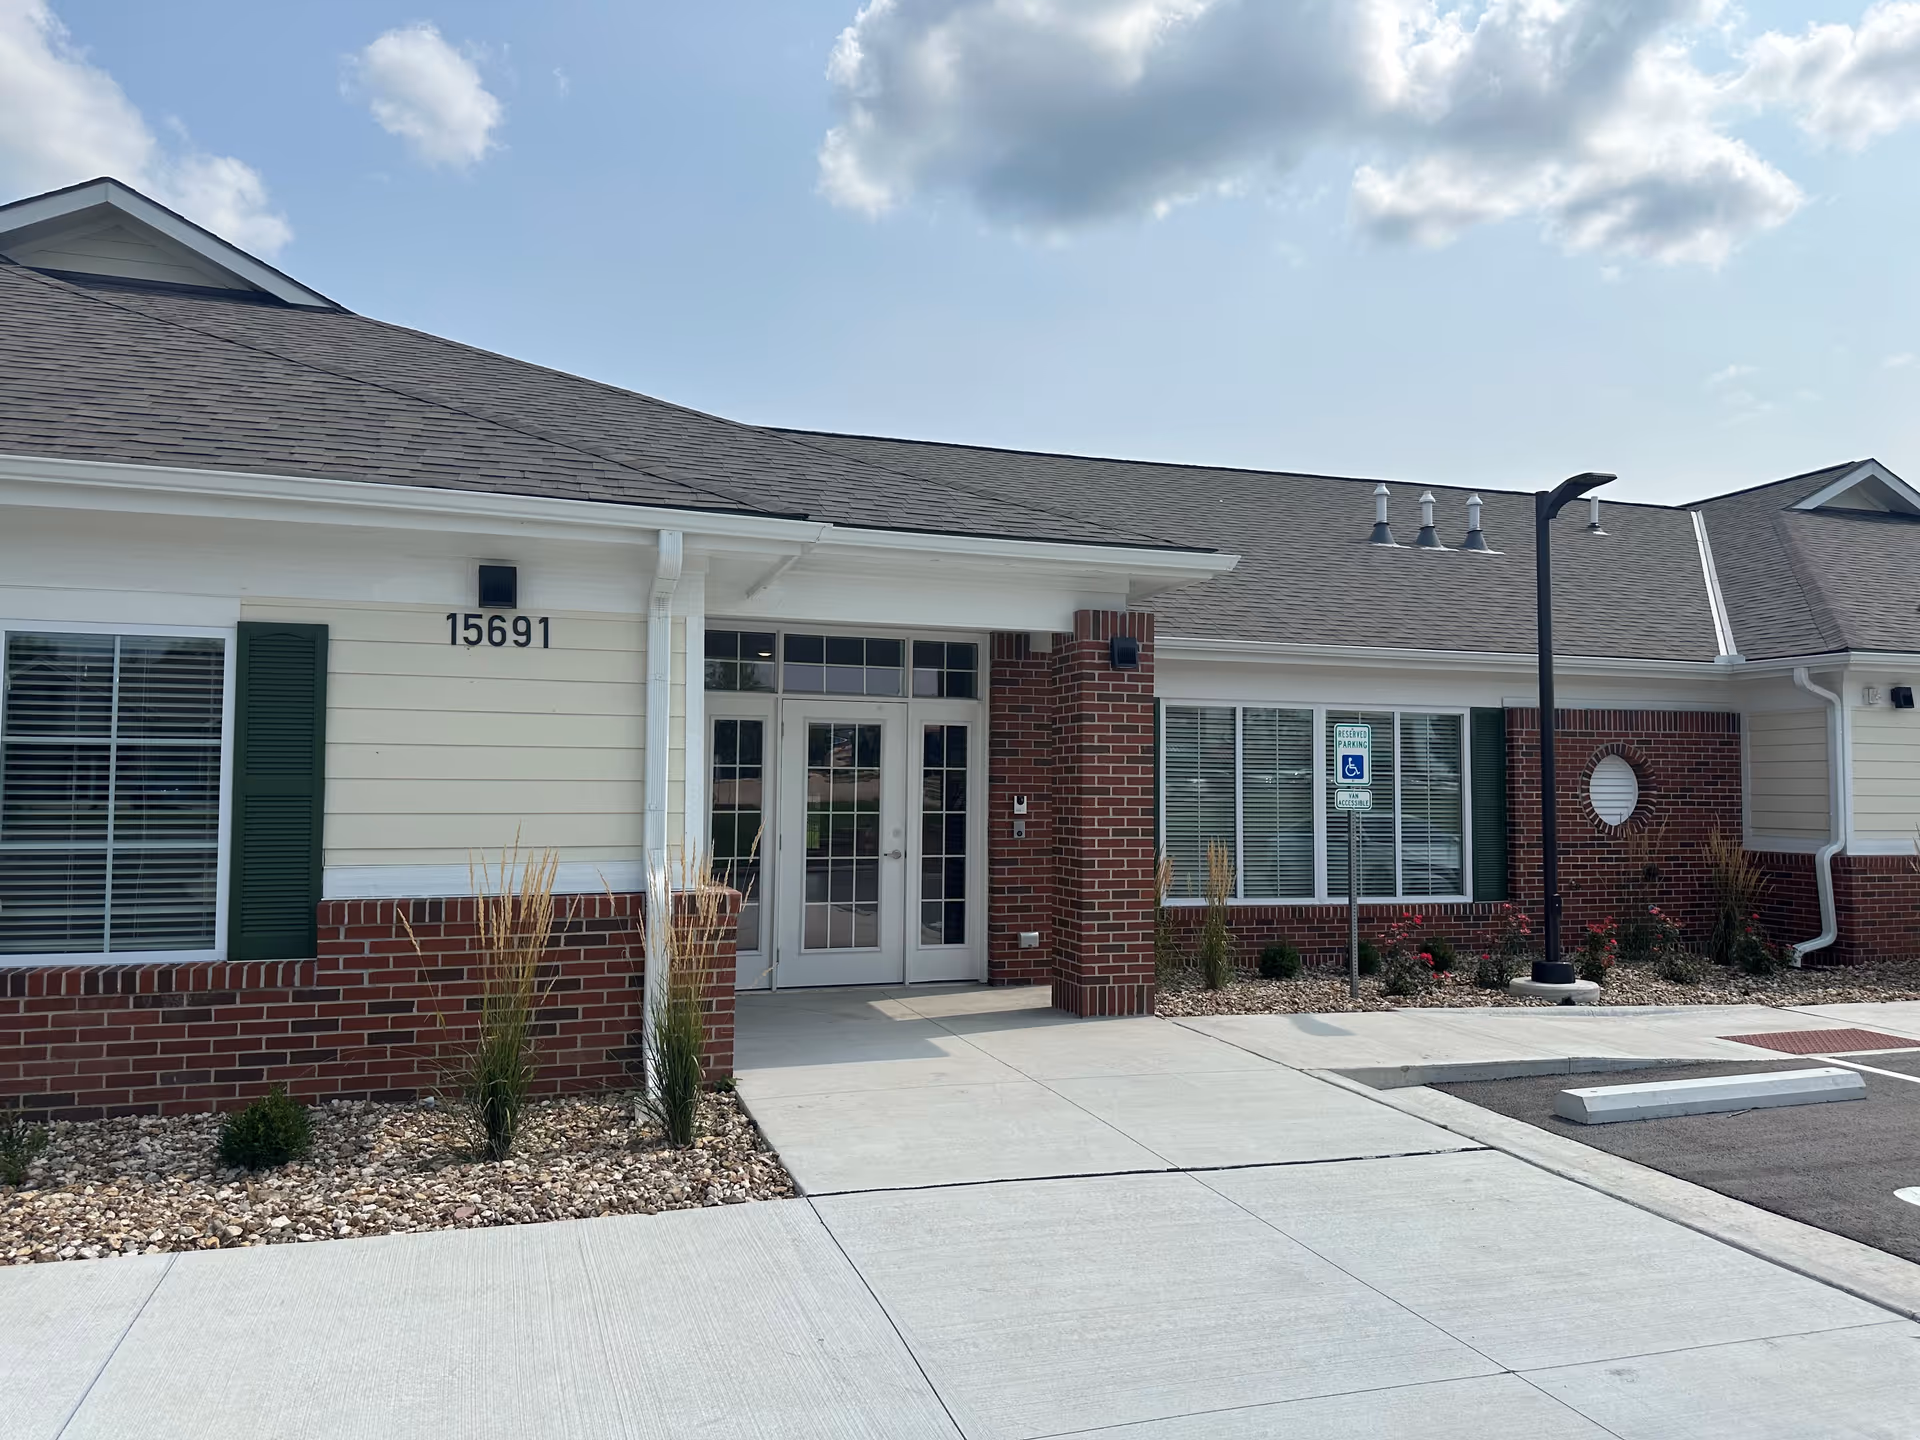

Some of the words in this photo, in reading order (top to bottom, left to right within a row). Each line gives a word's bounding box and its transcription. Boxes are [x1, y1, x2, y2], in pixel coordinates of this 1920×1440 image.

[446, 612, 549, 649] 15691
[1338, 730, 1367, 739] RESERVED
[1338, 740, 1368, 749] PARKING
[1338, 799, 1369, 807] ACCESSIBLE
